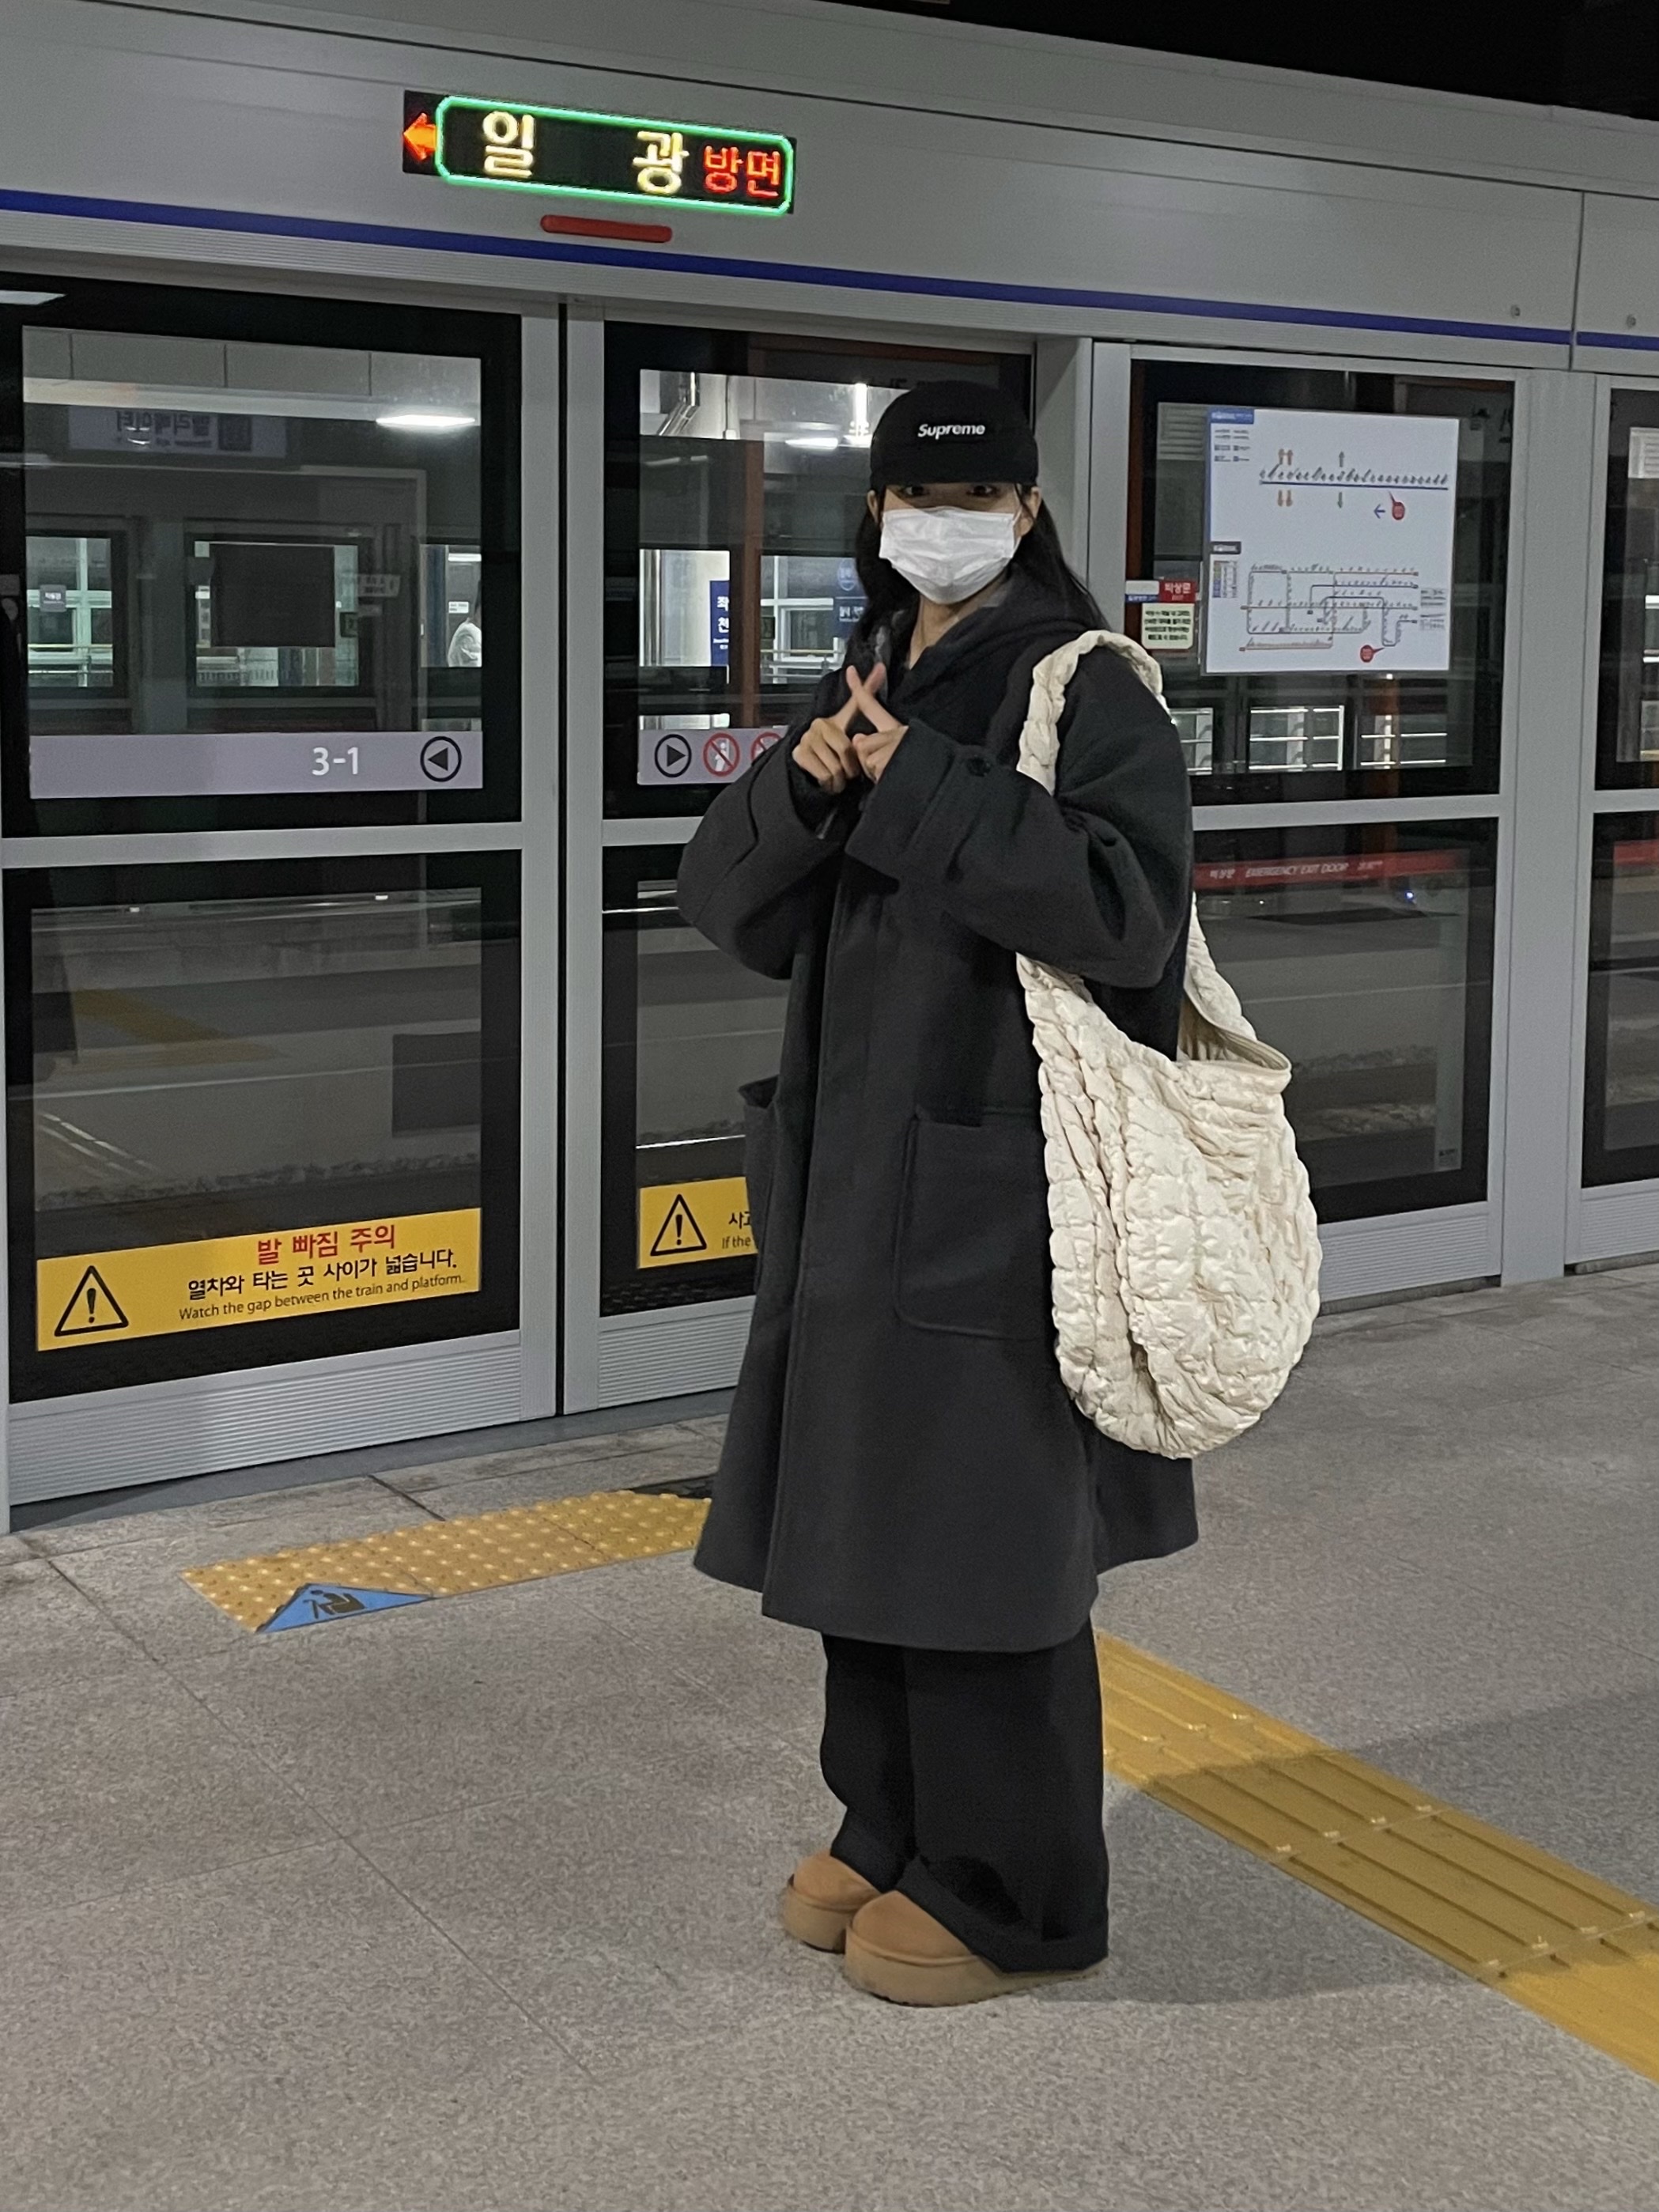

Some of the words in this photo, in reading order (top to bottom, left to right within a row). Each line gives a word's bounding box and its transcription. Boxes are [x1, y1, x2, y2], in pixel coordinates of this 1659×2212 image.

[482, 110, 535, 178] 일
[632, 130, 690, 195] 광
[703, 146, 780, 199] 방면
[917, 423, 986, 440] Supreme
[312, 747, 359, 776] 3-1
[258, 1238, 282, 1265] 발
[292, 1231, 338, 1259] 빠짐
[350, 1224, 395, 1253] 주의
[732, 1235, 751, 1248] the
[188, 1275, 245, 1301] 열차와
[252, 1270, 289, 1291] 타는
[297, 1265, 315, 1287] 곳
[323, 1257, 377, 1281] 사이가
[385, 1249, 457, 1276] 넓습니다.
[179, 1304, 220, 1320] Watch
[223, 1301, 244, 1314] the
[248, 1299, 272, 1314] gap
[274, 1291, 330, 1308] between
[332, 1287, 353, 1300] the
[356, 1283, 384, 1297] train
[386, 1278, 409, 1293] and
